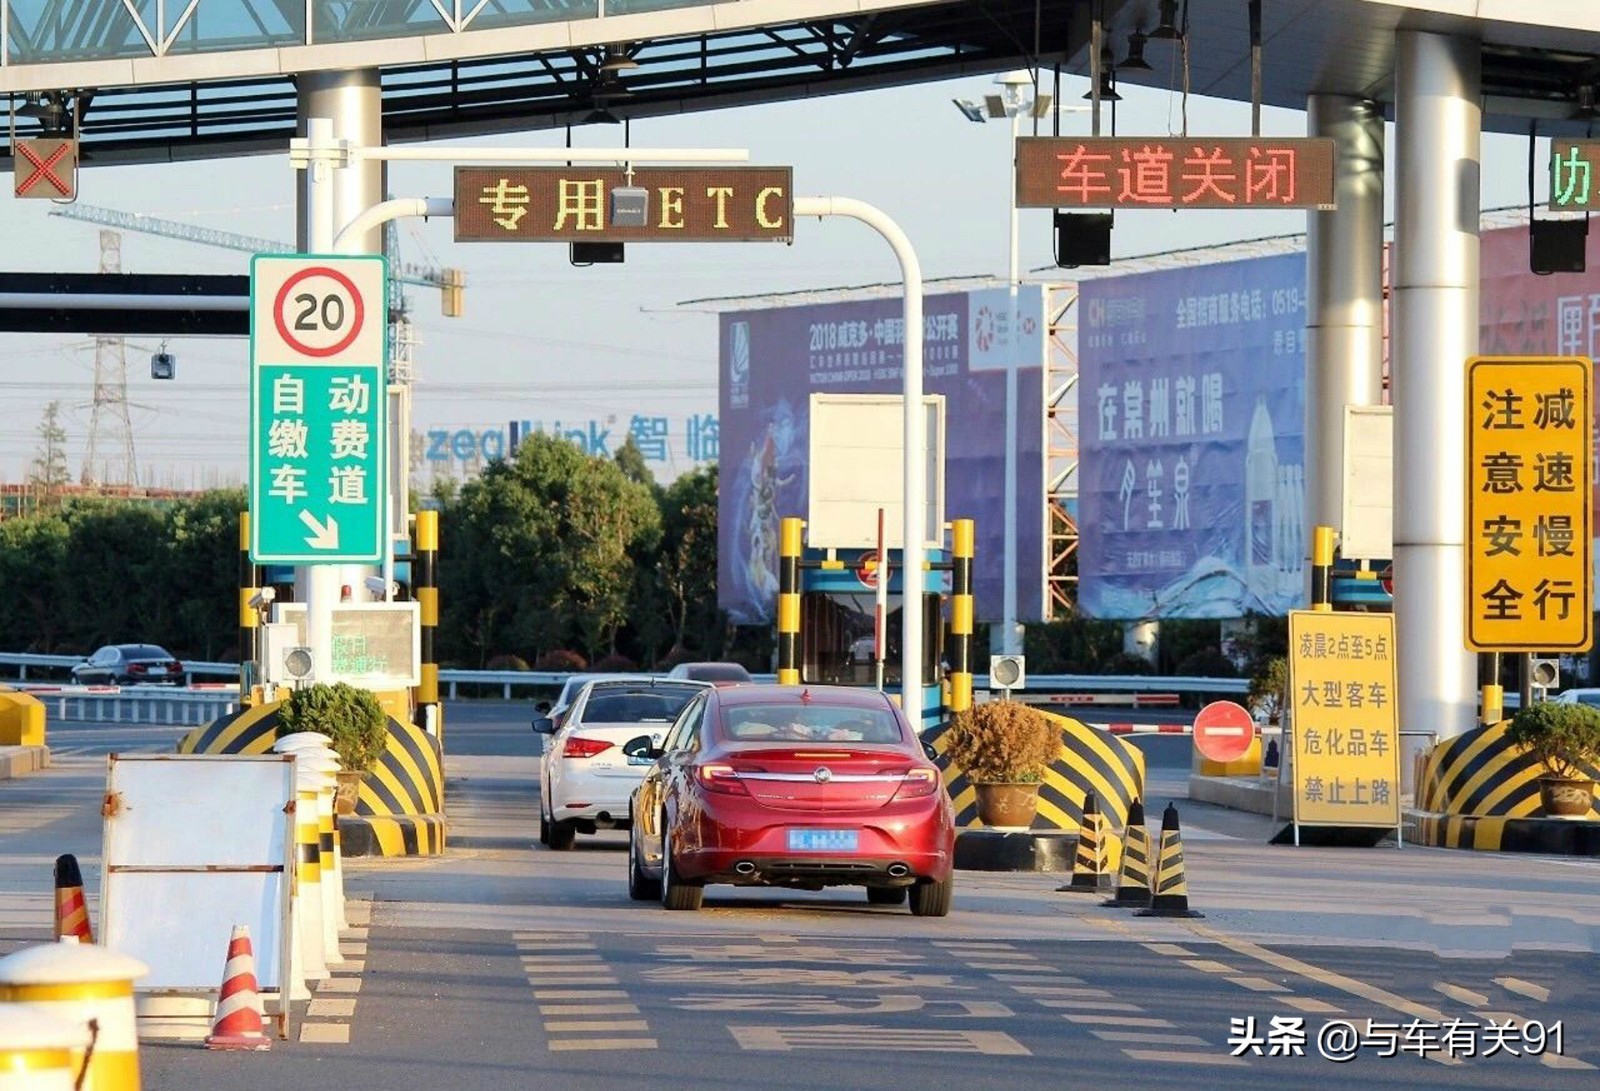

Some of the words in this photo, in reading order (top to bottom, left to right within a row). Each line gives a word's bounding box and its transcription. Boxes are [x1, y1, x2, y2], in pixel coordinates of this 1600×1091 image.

[1055, 144, 1296, 204] 车道关闭
[479, 178, 605, 231] 专用
[658, 186, 784, 230] ETC
[293, 292, 346, 331] 20
[272, 372, 370, 416] 自动
[267, 418, 370, 460] 缴费
[267, 463, 369, 506] 车道
[1481, 388, 1525, 621] 注意安全
[1533, 388, 1576, 621] 减速慢行
[1299, 632, 1388, 660] 凌晨2点至5点
[1301, 679, 1388, 709] 大型客车
[1303, 727, 1389, 757] 危化品车
[1304, 775, 1390, 805] 禁止上路
